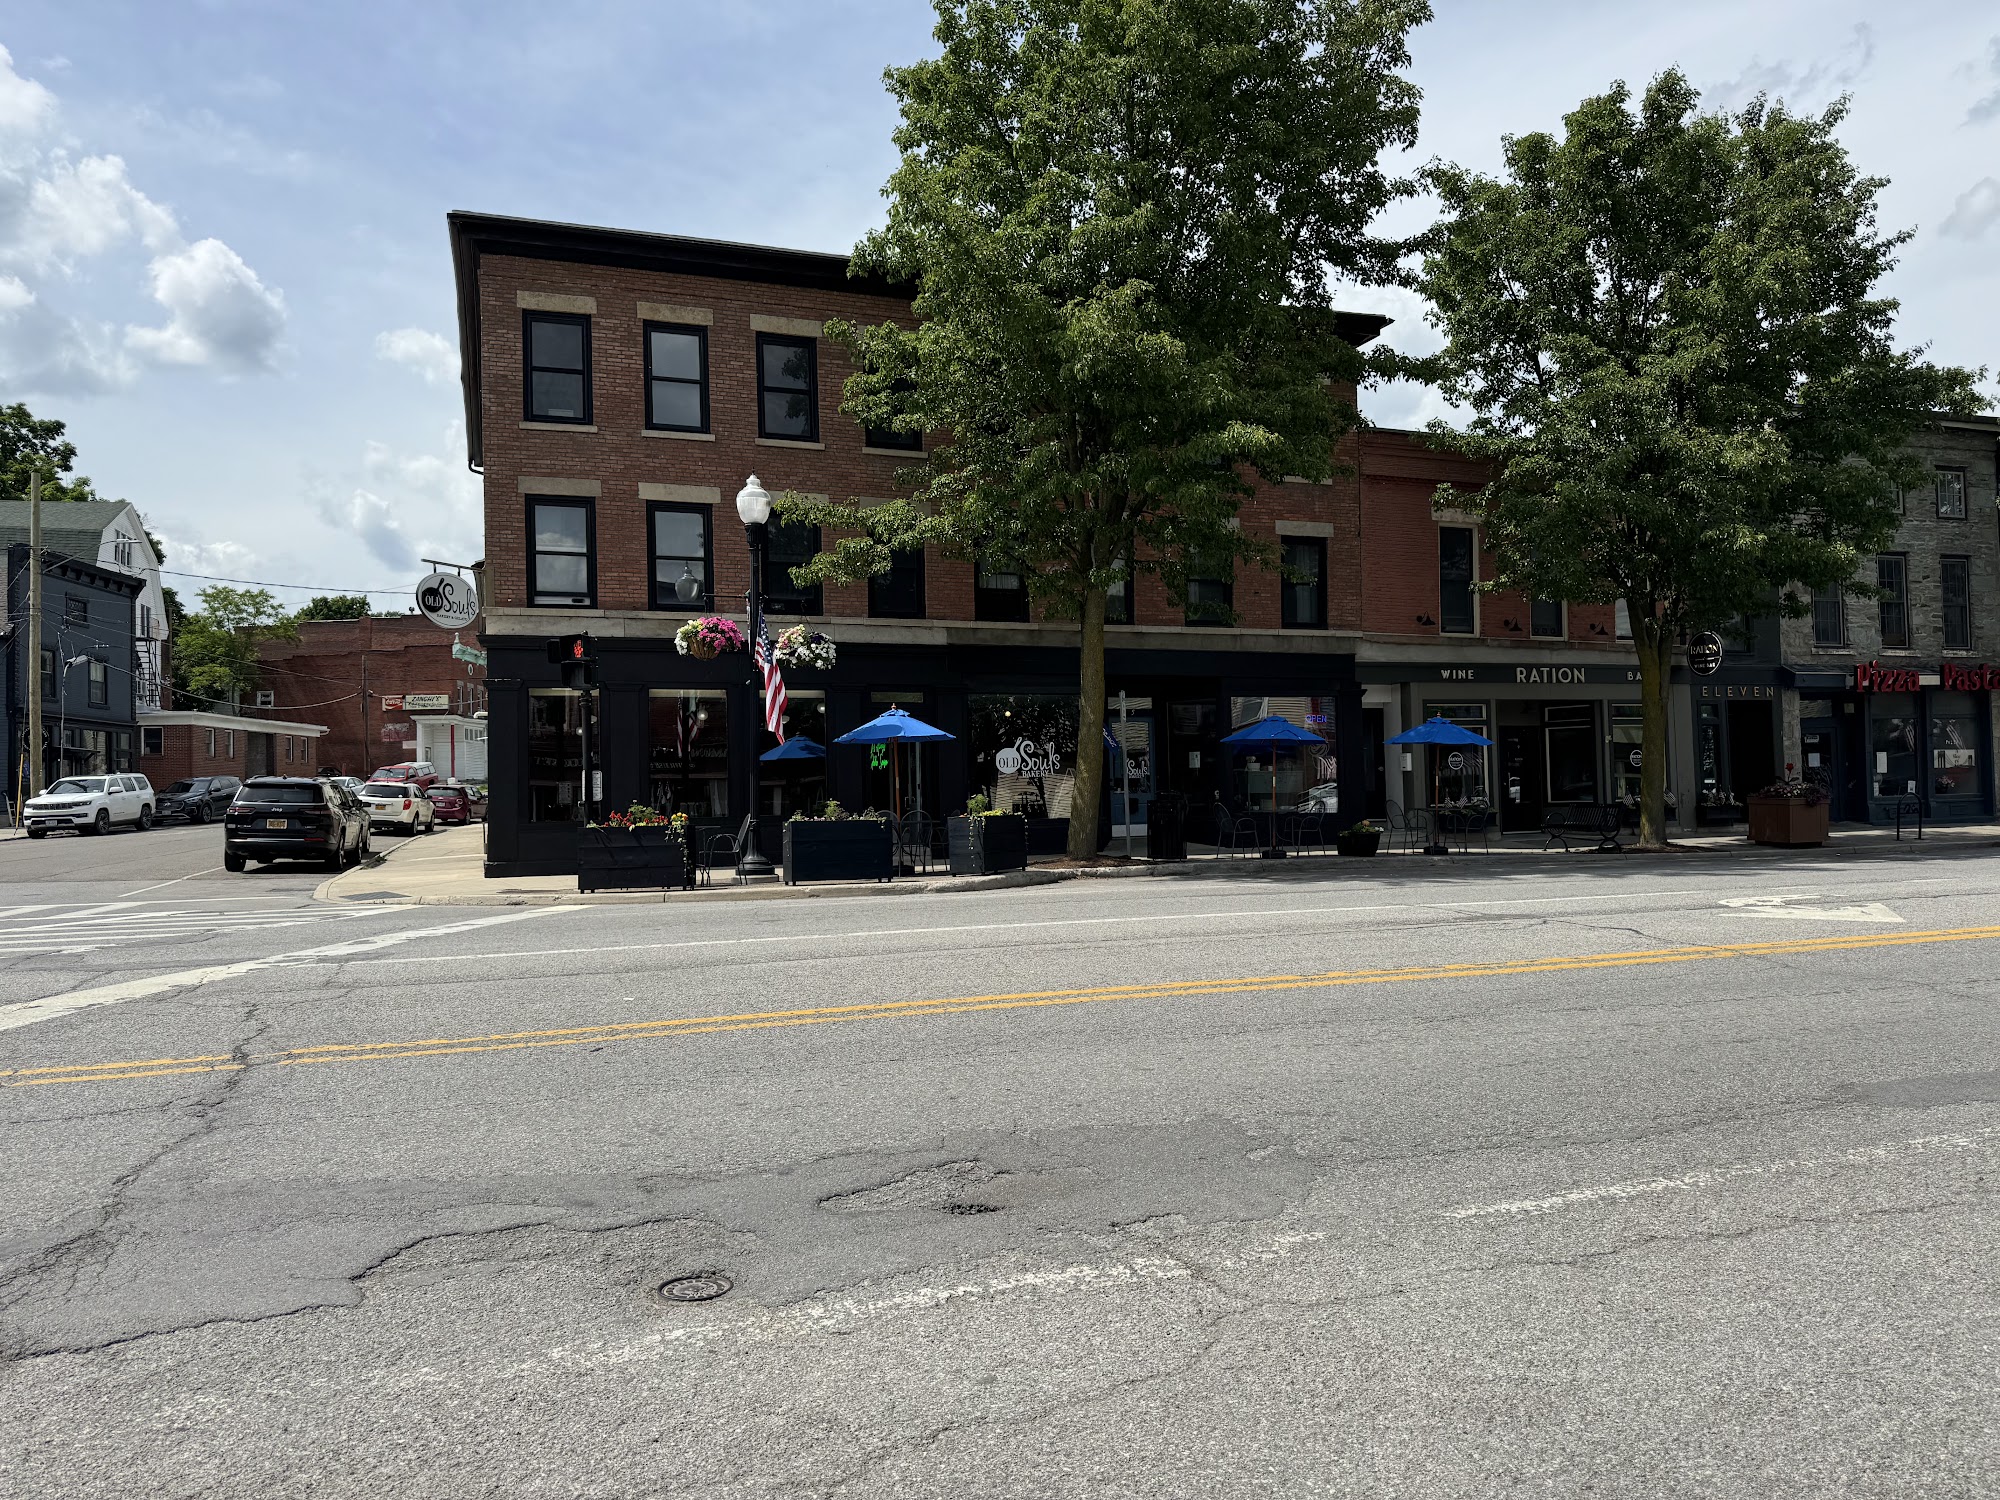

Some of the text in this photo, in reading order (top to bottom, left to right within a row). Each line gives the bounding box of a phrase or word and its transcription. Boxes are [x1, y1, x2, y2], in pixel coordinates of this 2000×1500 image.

[425, 582, 476, 620] OLD Souls
[1690, 643, 1719, 655] RATION
[1440, 667, 1643, 684] WINE RATION BA
[1856, 660, 1920, 692] Pizza
[1702, 686, 1774, 697] ELEVEN
[1305, 714, 1327, 723] OPEN
[998, 740, 1061, 776] OLD Souls
[1022, 770, 1049, 778] BAKERY
